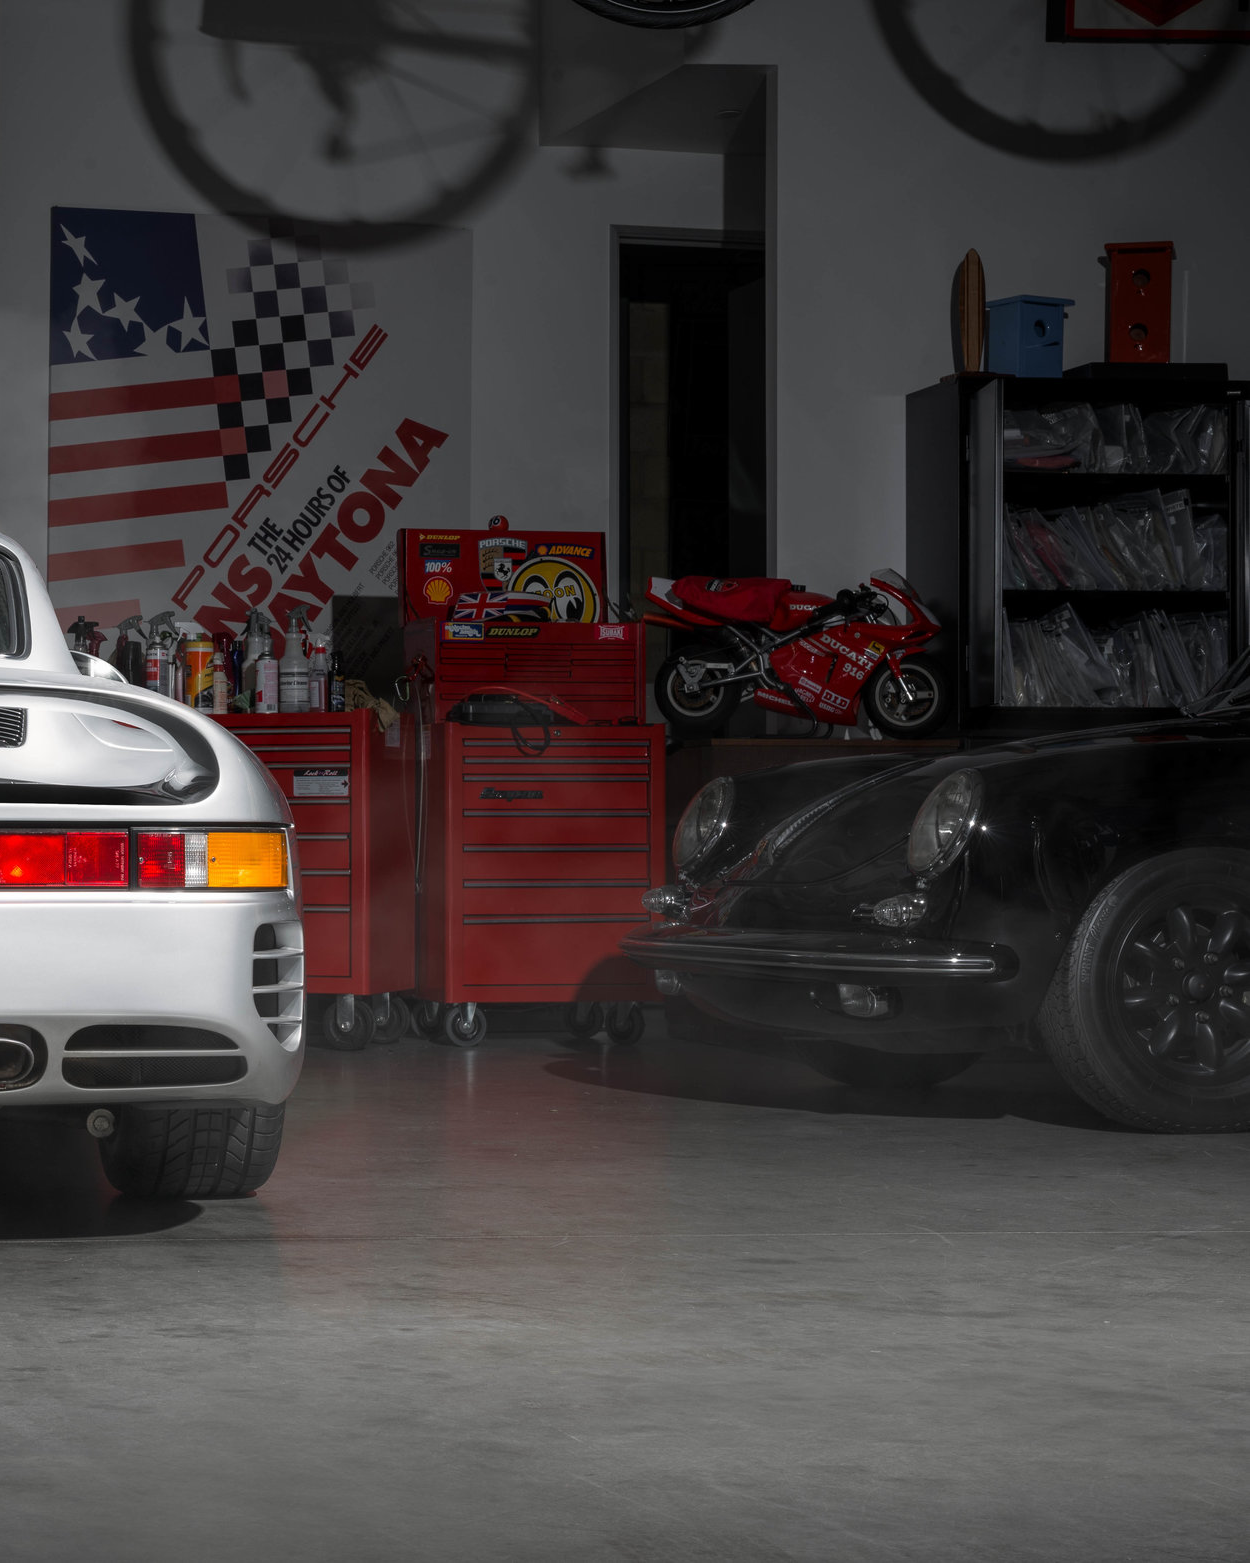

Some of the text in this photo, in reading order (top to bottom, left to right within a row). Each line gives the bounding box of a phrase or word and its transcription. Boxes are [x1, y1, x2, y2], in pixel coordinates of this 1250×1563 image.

[171, 324, 388, 610] PORSCHE
[266, 465, 351, 575] 24 HOURS OF
[247, 516, 284, 557] THE
[479, 538, 526, 549] PORSCHE
[548, 545, 592, 557] ADVANCE
[425, 562, 452, 574] 100%
[488, 628, 538, 636] DUNLOP
[819, 634, 874, 671] DUCATI
[842, 662, 865, 681] 916
[757, 691, 795, 707] MICHEL
